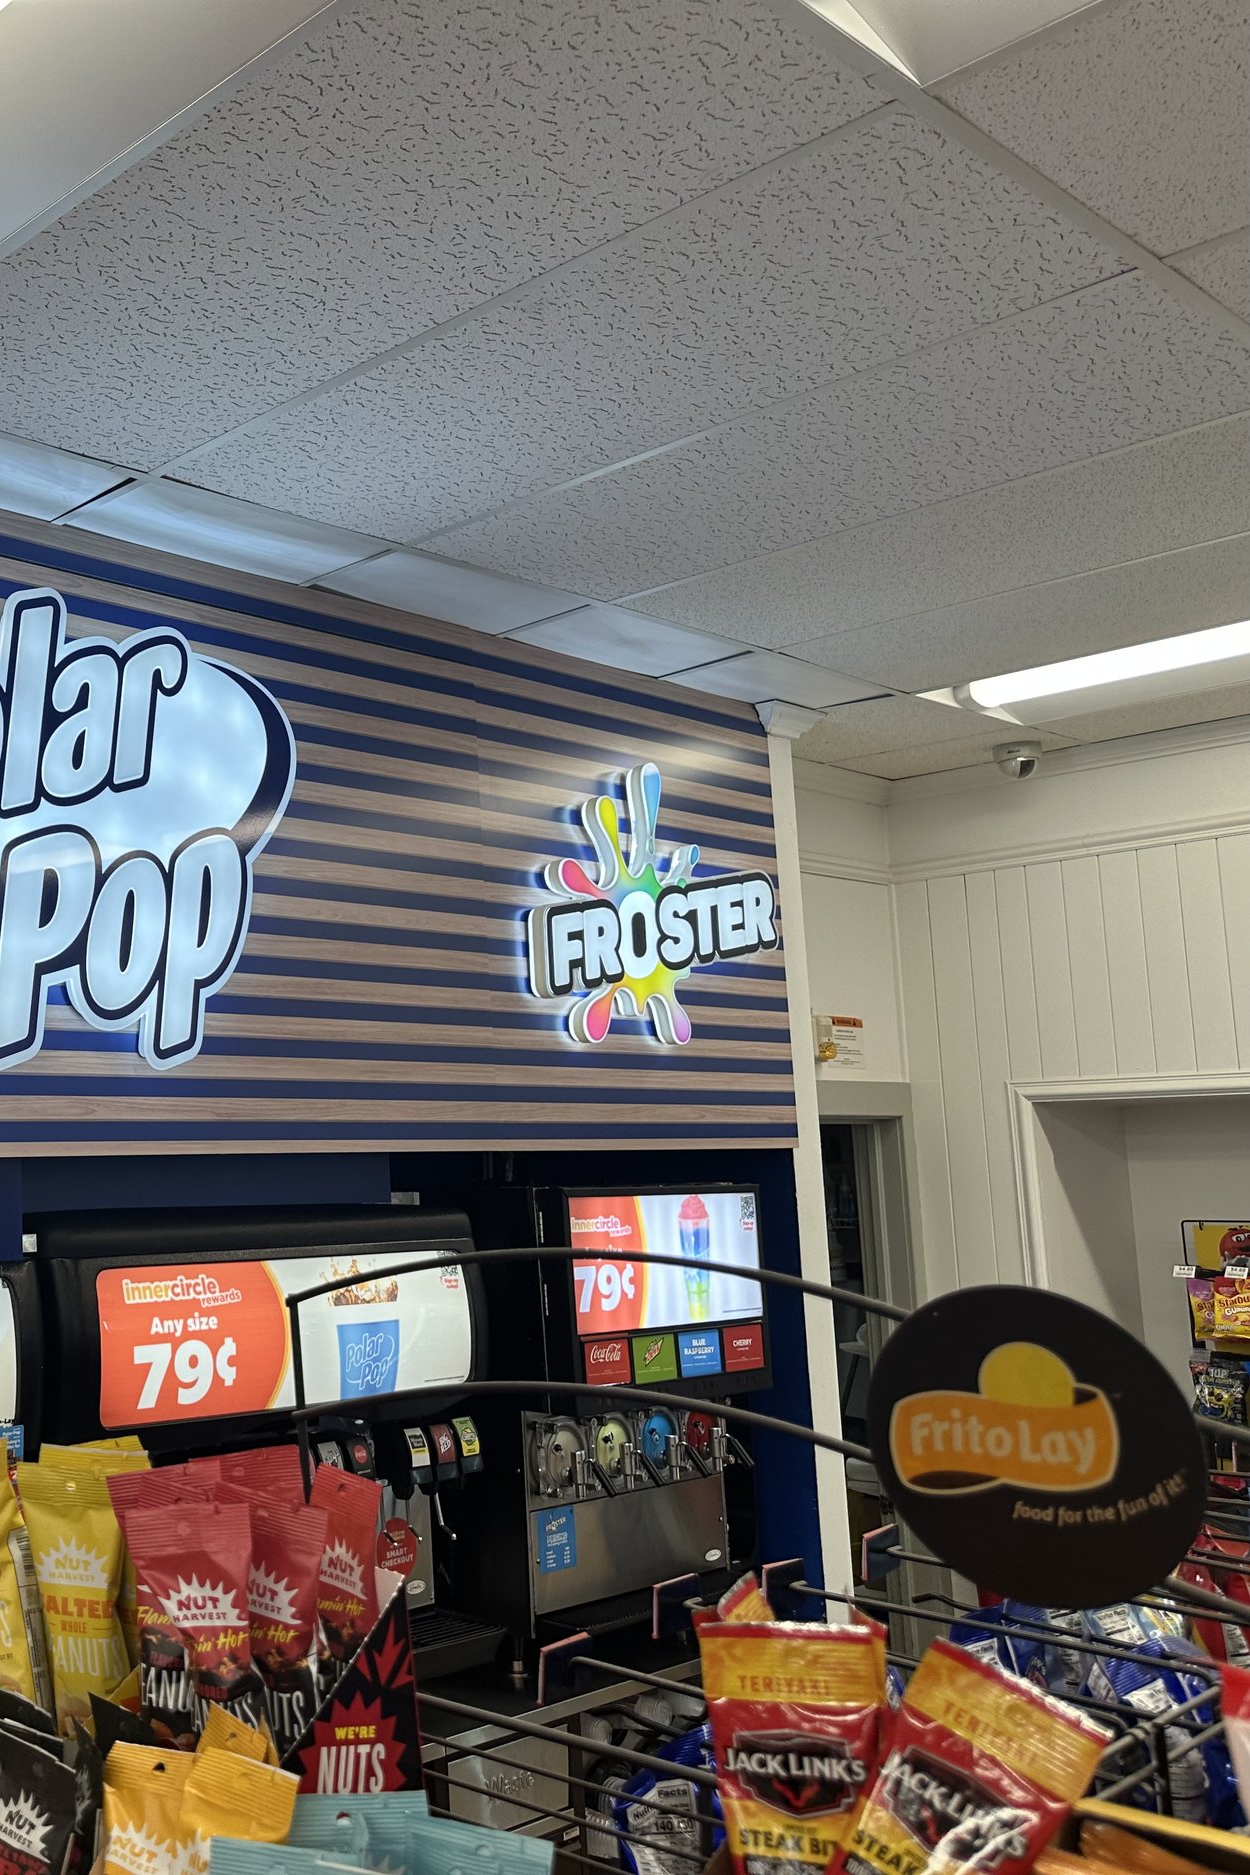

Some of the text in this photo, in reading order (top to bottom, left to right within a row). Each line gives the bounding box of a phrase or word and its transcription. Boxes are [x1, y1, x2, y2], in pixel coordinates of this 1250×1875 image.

[550, 878, 777, 988] FROSTER
[123, 1276, 218, 1302] innercircle
[201, 1290, 241, 1307] rewards
[574, 1264, 635, 1312] 79¢
[150, 1312, 218, 1337] Any size
[345, 1332, 384, 1373] Polar
[684, 1346, 715, 1355] RASPBERRY
[691, 1338, 706, 1346] BLUE
[732, 1338, 753, 1348] CHERRY
[133, 1337, 237, 1410] 79¢
[358, 1358, 390, 1391] Pop
[1012, 1501, 1054, 1521] food
[1057, 1506, 1082, 1527] for
[1086, 1505, 1116, 1522] the
[1117, 1500, 1149, 1521] fun
[1149, 1483, 1169, 1506] of
[54, 1556, 92, 1570] NUT
[381, 1554, 414, 1569] CHECKOUT
[386, 1547, 408, 1559] SMART
[49, 1570, 96, 1583] HARVEST
[327, 1554, 356, 1577] NUT
[319, 1567, 357, 1590] HARVEST
[177, 1594, 221, 1612] NUT
[60, 1620, 87, 1634] WHOLE
[173, 1612, 228, 1622] HARVEST
[216, 1629, 249, 1652] Hot
[267, 1623, 300, 1644] Hot
[334, 1725, 376, 1740] WE'RE
[317, 1743, 386, 1795] NUTS
[726, 1748, 868, 1782] JACK LINK'S
[657, 1788, 688, 1799] Facts
[5, 1809, 36, 1836] NUT
[654, 1820, 674, 1832] 140
[110, 1836, 158, 1863] NUT
[739, 1828, 804, 1851] STEAK
